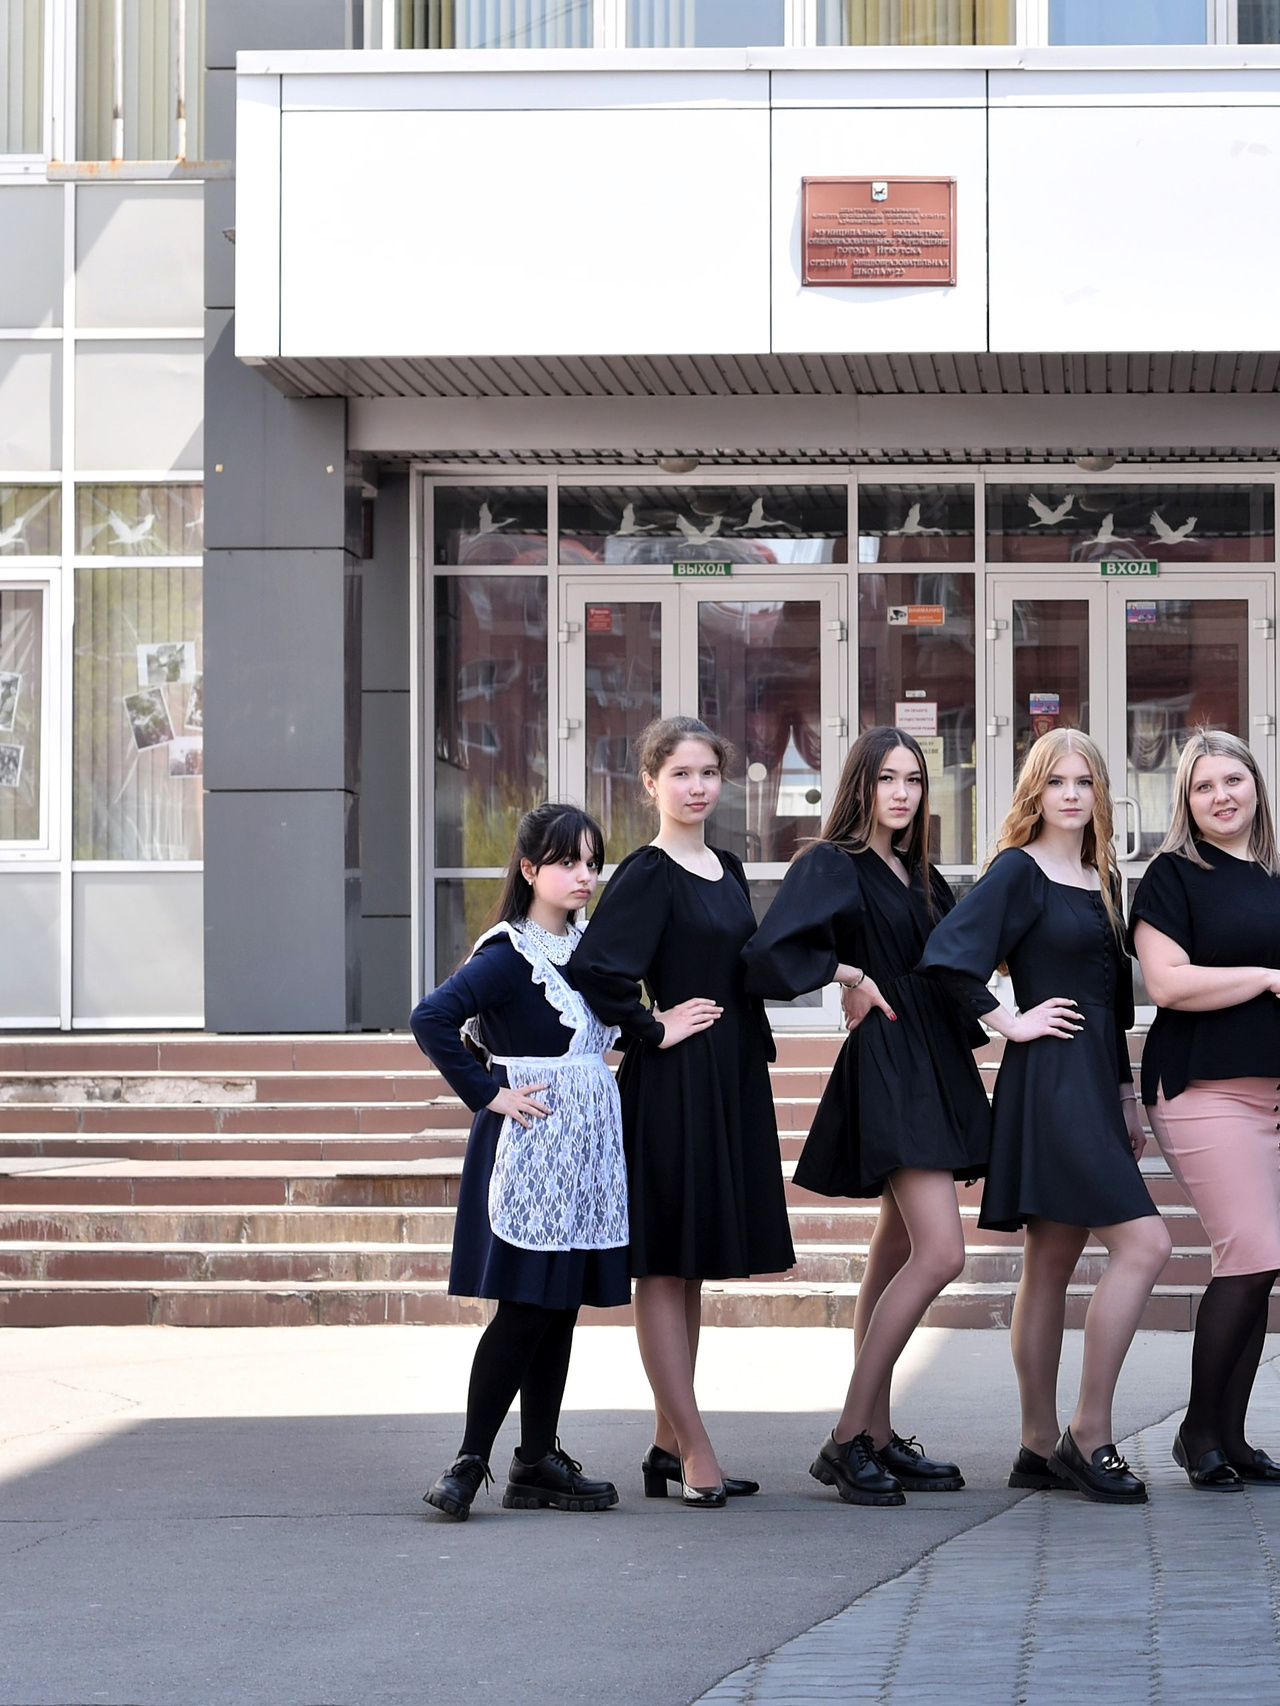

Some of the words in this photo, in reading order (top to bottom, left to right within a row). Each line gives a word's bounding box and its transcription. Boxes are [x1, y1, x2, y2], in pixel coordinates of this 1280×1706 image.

[814, 228, 888, 237] МУНИЦИПАЛЬНОЕ
[836, 246, 871, 255] ГОРОДА
[809, 258, 848, 267] СРЕДНЯЯ
[853, 267, 886, 276] ШКОЛА
[677, 563, 726, 575] ВЫХОД
[1106, 562, 1151, 575] ВХОД
